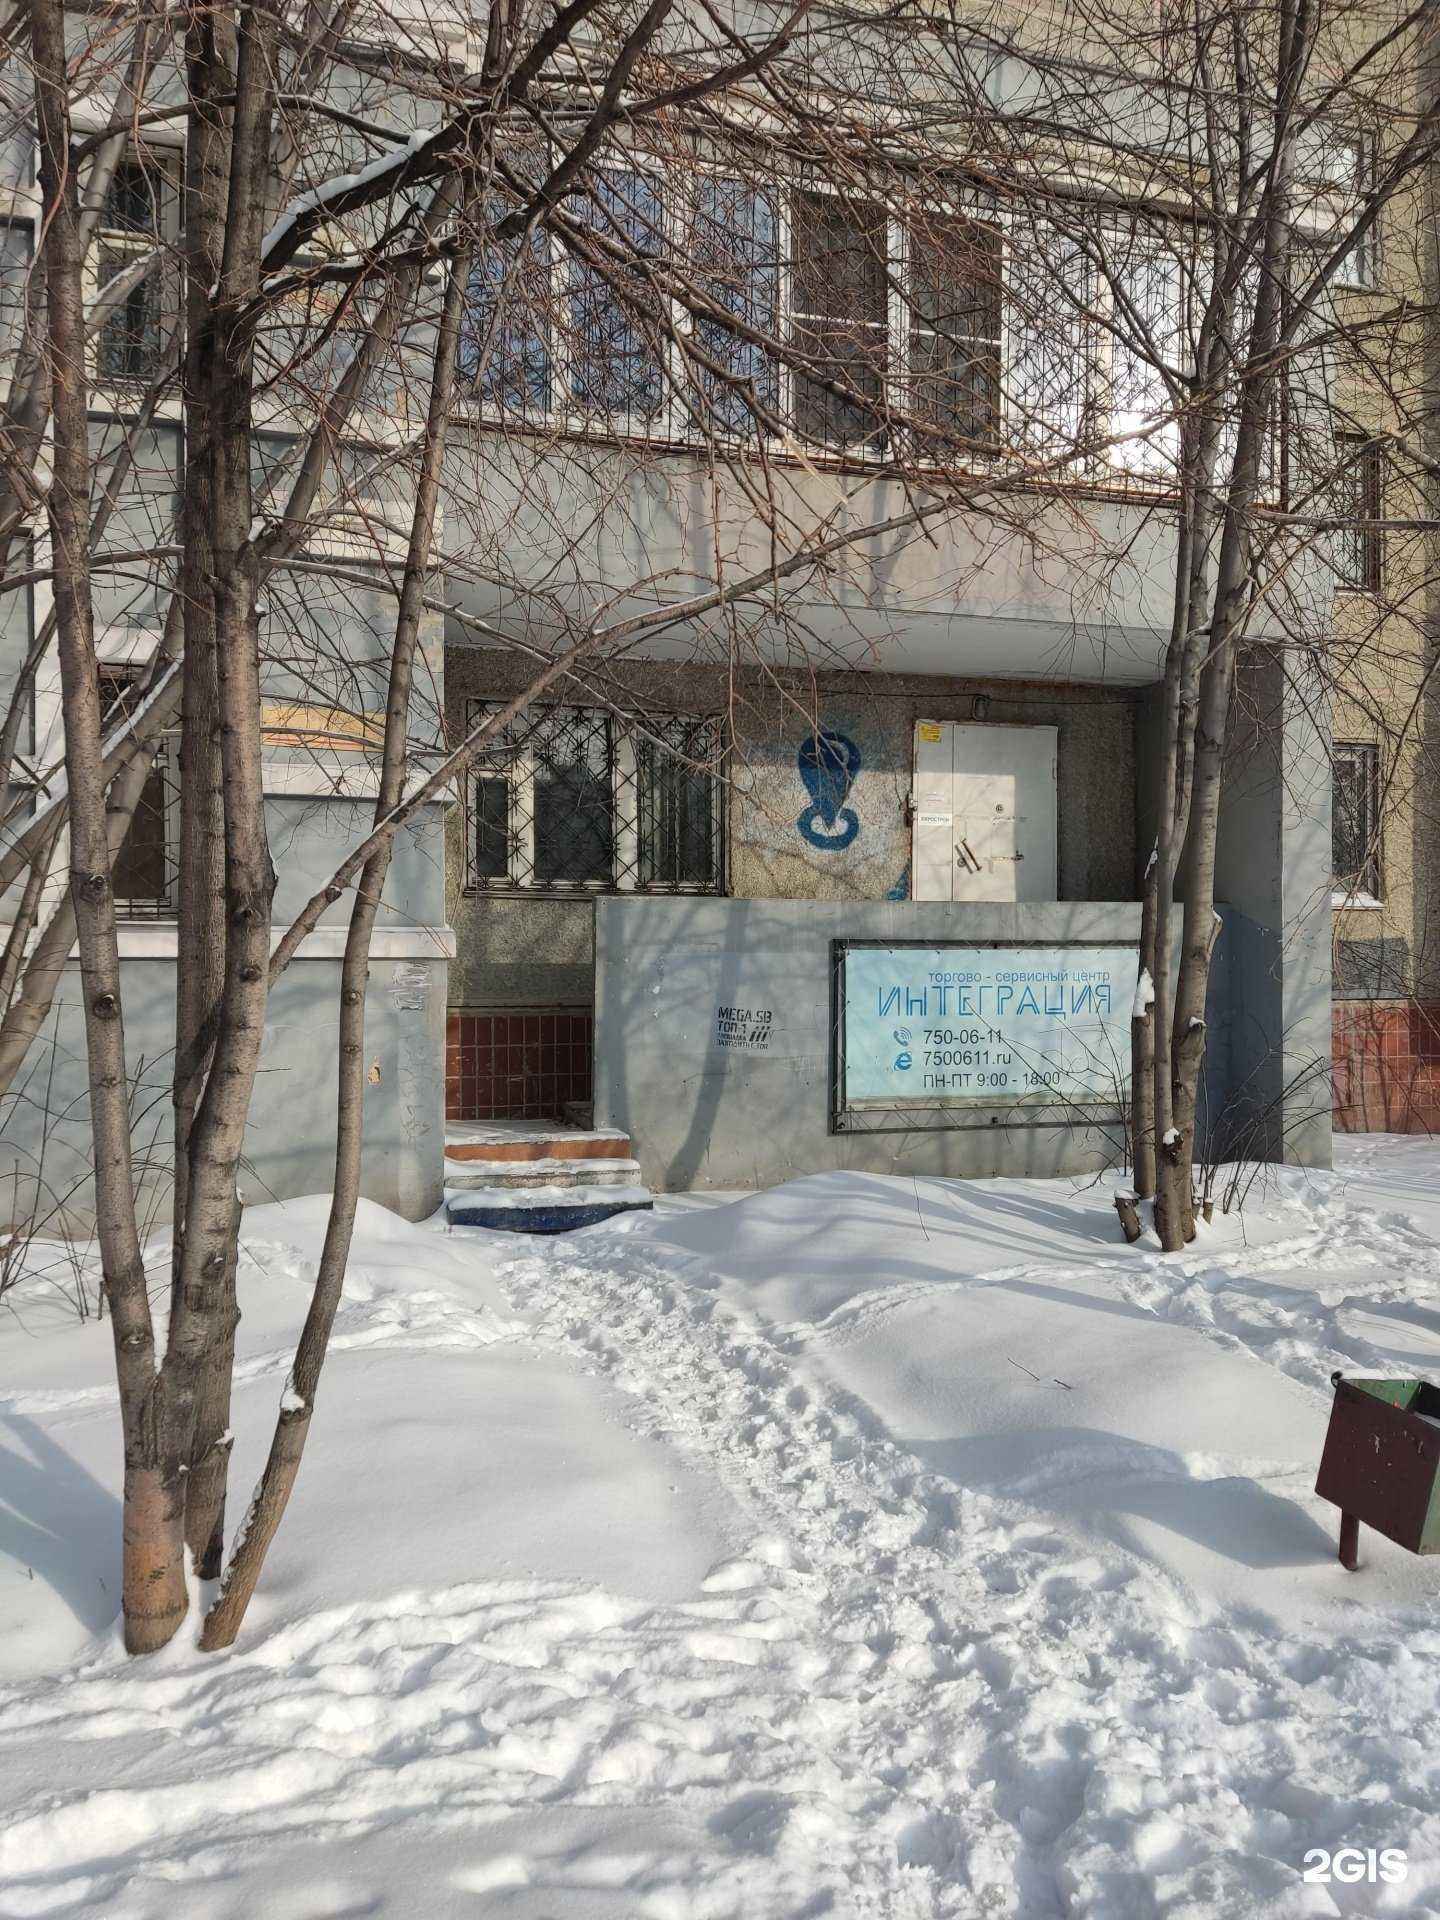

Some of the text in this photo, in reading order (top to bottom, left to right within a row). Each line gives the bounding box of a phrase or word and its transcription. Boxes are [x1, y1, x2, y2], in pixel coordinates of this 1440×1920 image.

[928, 972, 982, 985] торгово
[995, 969, 1068, 984] сервисный
[1073, 971, 1110, 984] центр
[878, 984, 1111, 1019] ИНТЕГРАЦИЯ
[923, 1029, 1002, 1044] 750-06-11
[923, 1050, 1012, 1066] 7500611.ru
[923, 1073, 972, 1088] ПН-ПТ
[977, 1072, 1008, 1087] 9:00
[1023, 1071, 1060, 1086] 18:00
